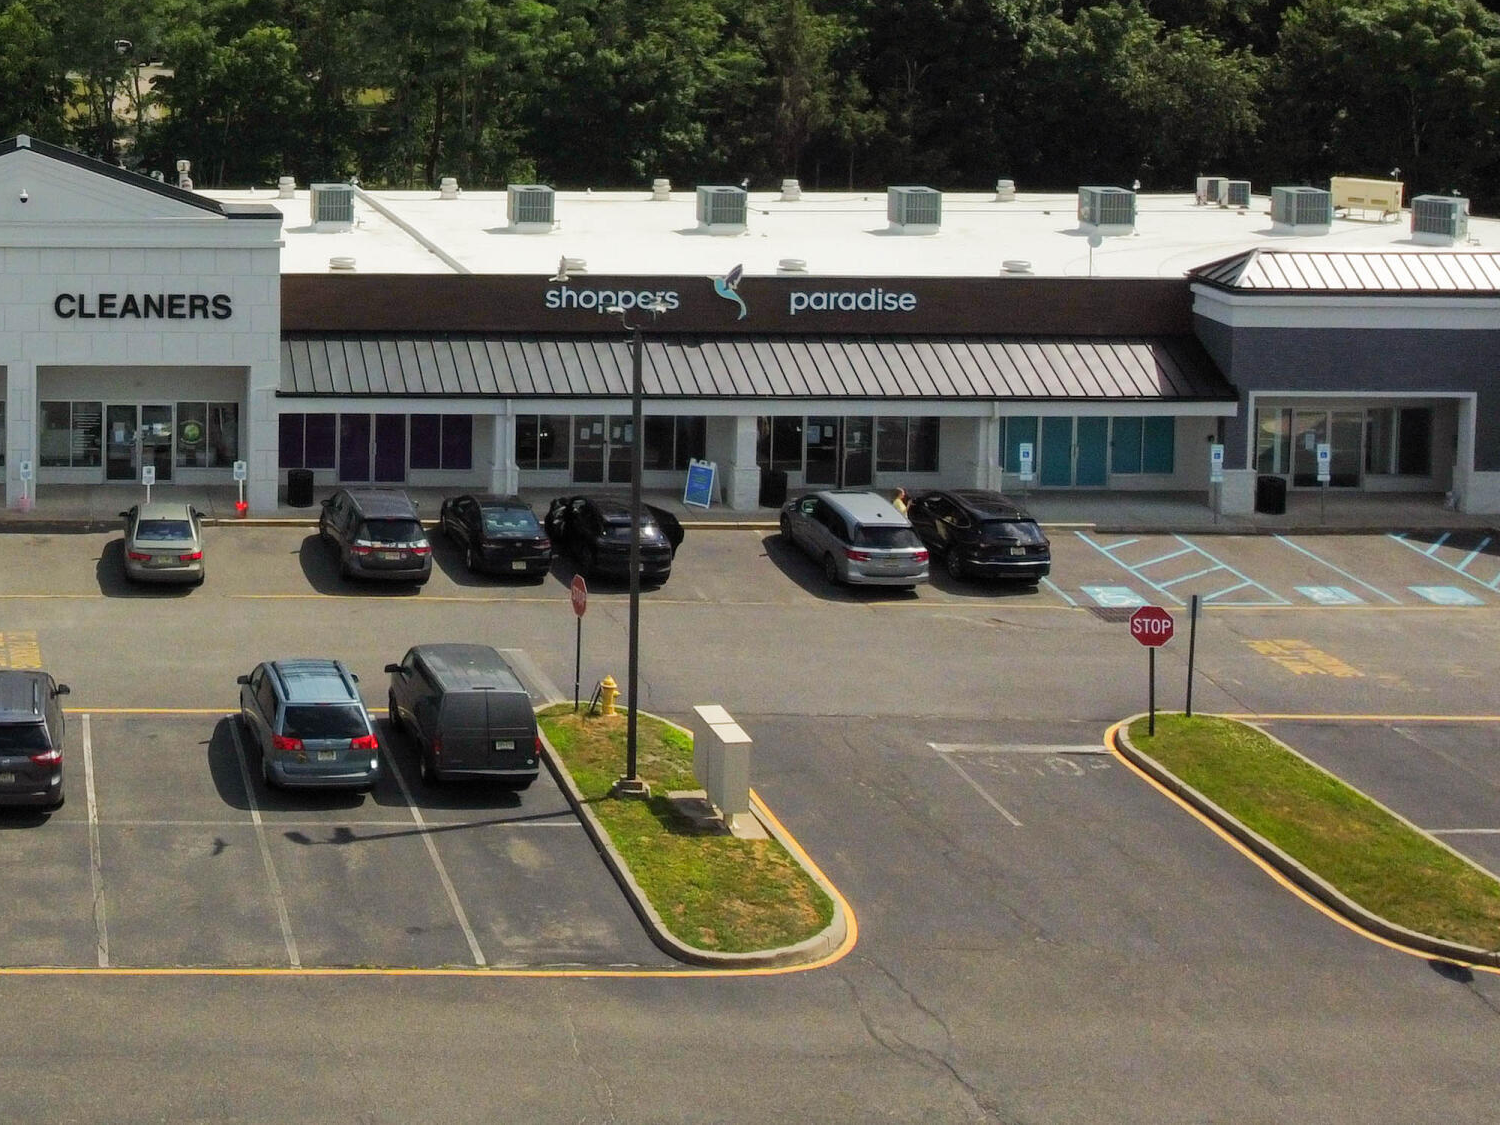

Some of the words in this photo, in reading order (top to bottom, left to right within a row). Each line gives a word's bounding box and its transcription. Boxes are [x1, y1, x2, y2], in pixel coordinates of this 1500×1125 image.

[54, 293, 233, 320] CLEANERS
[789, 288, 917, 315] paradise
[1133, 618, 1171, 635] STOP
